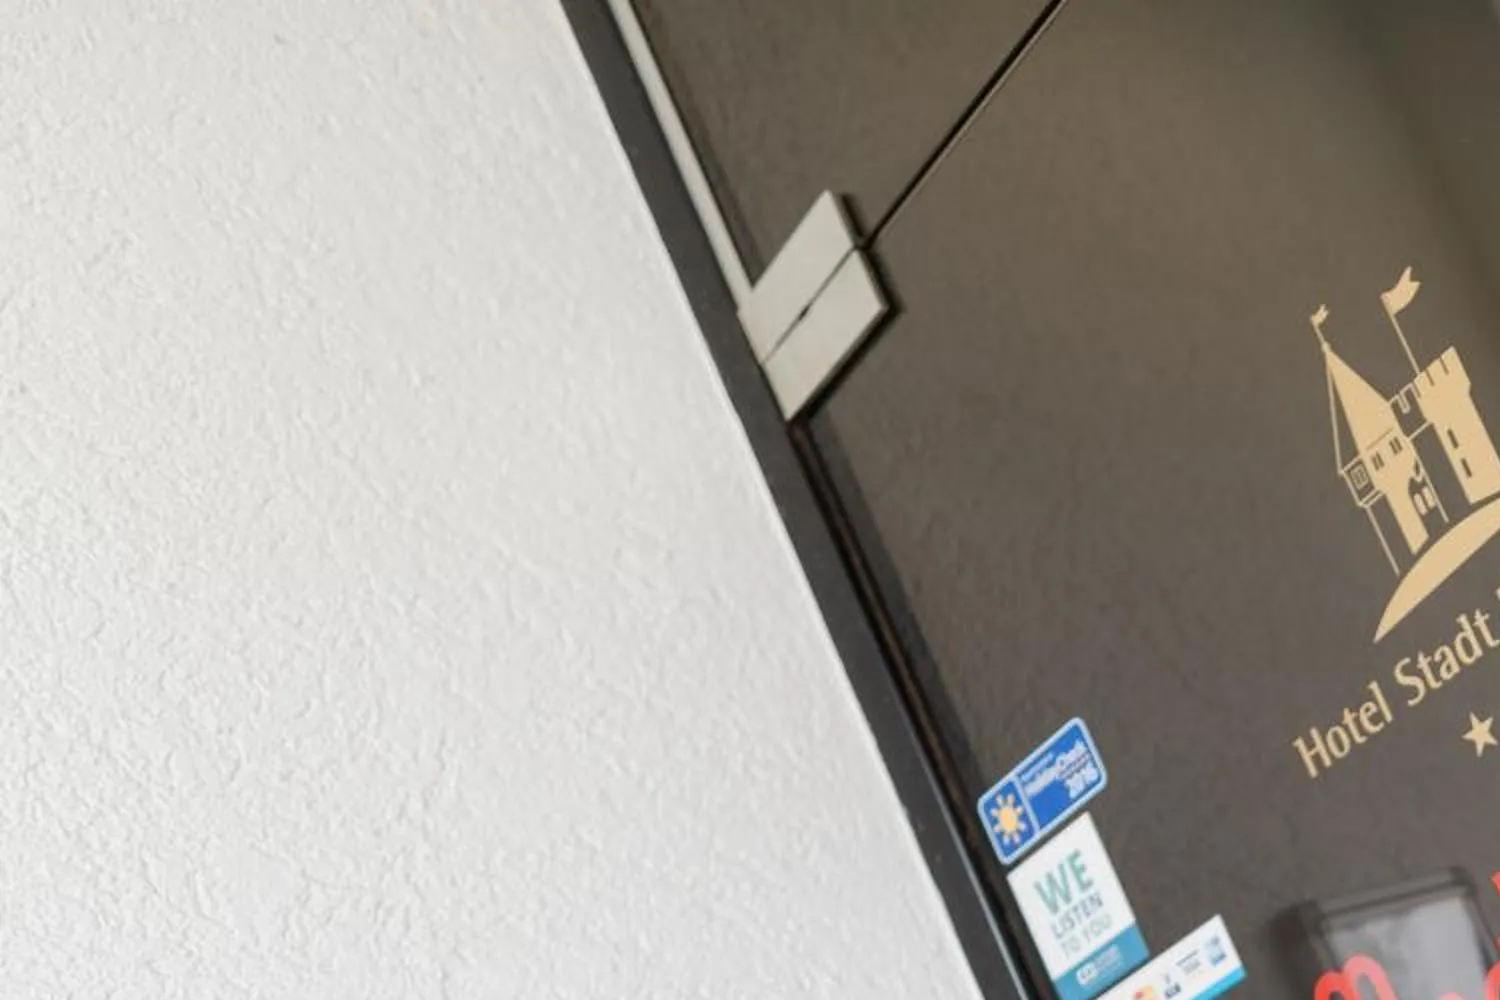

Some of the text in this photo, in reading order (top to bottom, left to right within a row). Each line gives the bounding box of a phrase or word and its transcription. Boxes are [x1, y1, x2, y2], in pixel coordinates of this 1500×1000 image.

[1292, 681, 1393, 779] Hotel
[1393, 608, 1500, 707] Stadt
[1033, 849, 1094, 916] WE
[1050, 891, 1104, 940] LISTEN
